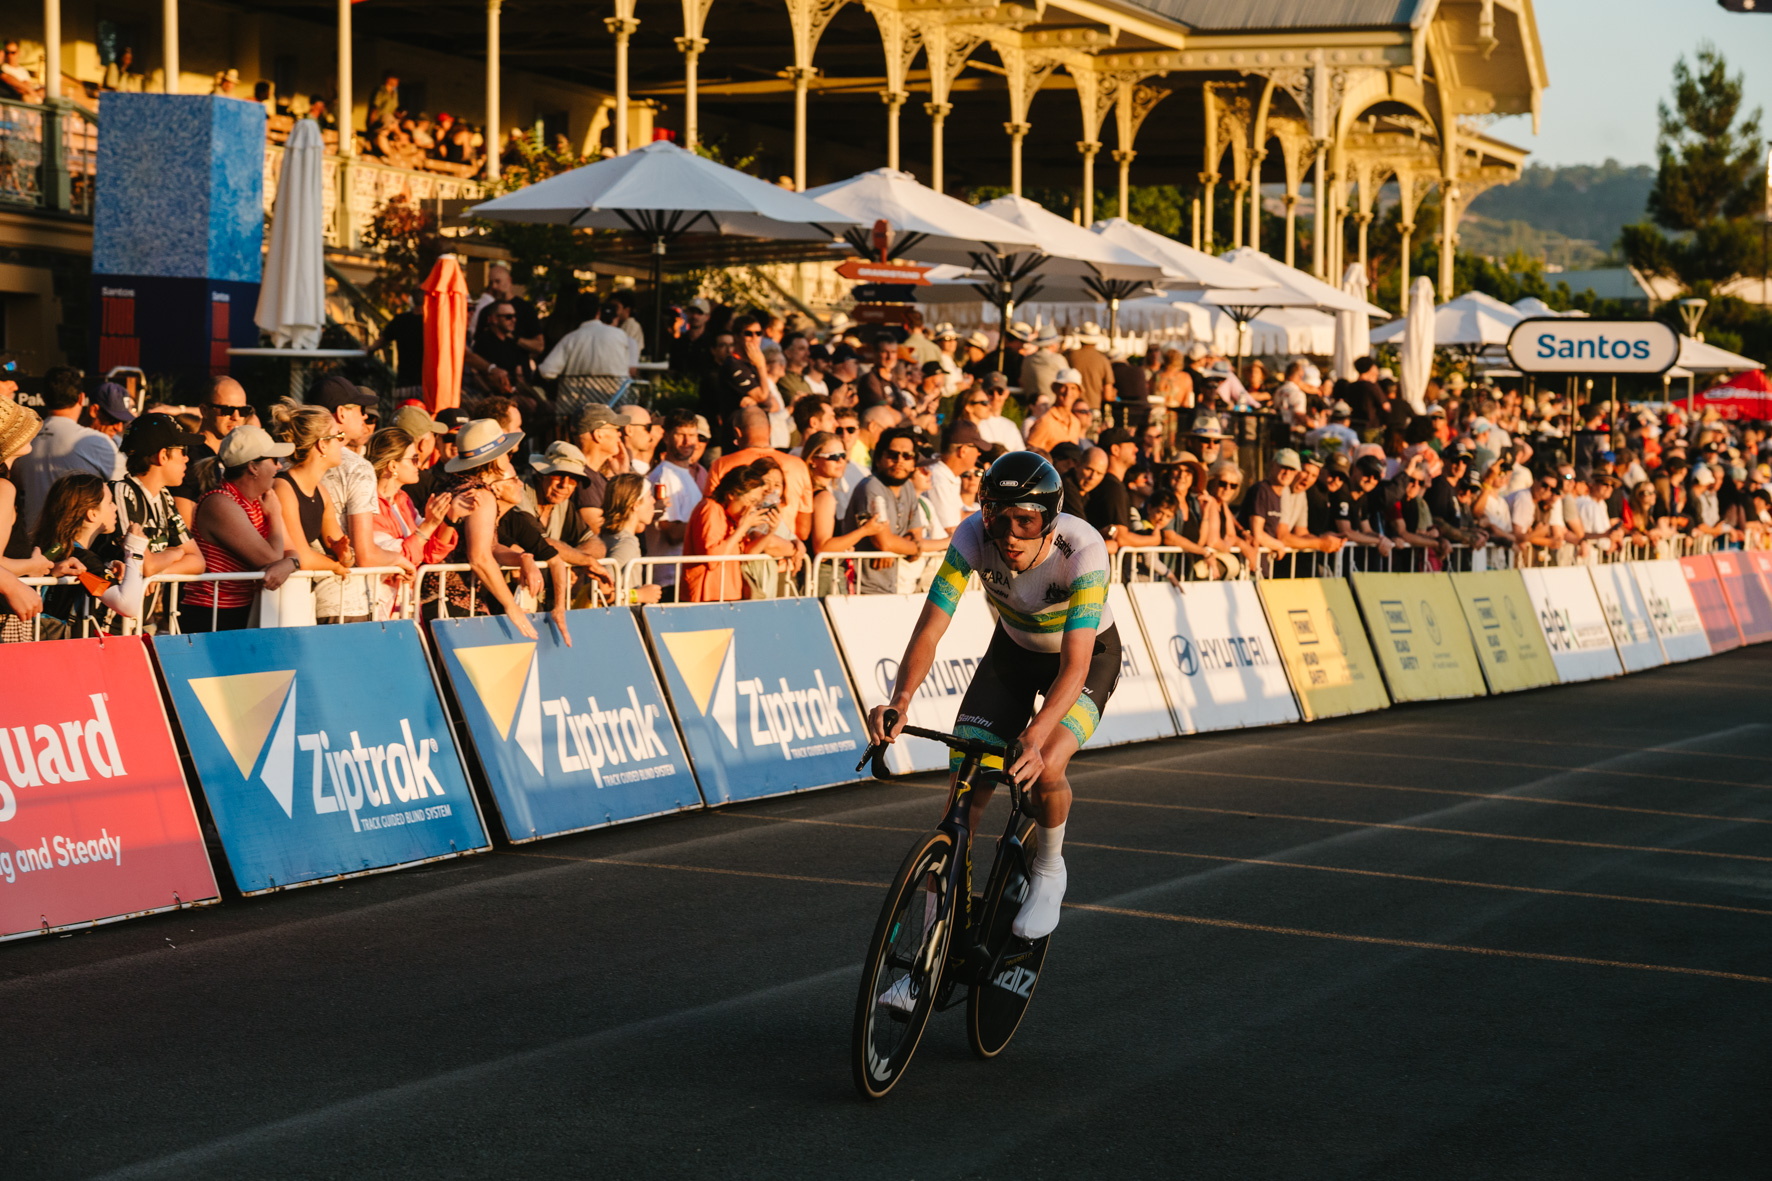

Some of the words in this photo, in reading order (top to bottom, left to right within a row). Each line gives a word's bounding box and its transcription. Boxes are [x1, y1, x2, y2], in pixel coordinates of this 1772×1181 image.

[1537, 334, 1650, 359] Santos
[1054, 533, 1076, 560] Santini
[1196, 636, 1269, 670] HYUNDAI
[737, 669, 850, 760] Ziptrak
[957, 713, 994, 728] Santini
[542, 685, 668, 789] Ziptrak
[0, 693, 128, 822] uard
[297, 719, 445, 832] Ziptrak
[602, 774, 621, 787] TRACK
[654, 764, 676, 778] SYSTEM
[361, 817, 382, 831] TRACK
[381, 813, 405, 828] GUIDED
[404, 809, 425, 823] BLIND
[425, 804, 452, 820] SYSTEM
[16, 837, 54, 873] and
[53, 828, 121, 866] Steady
